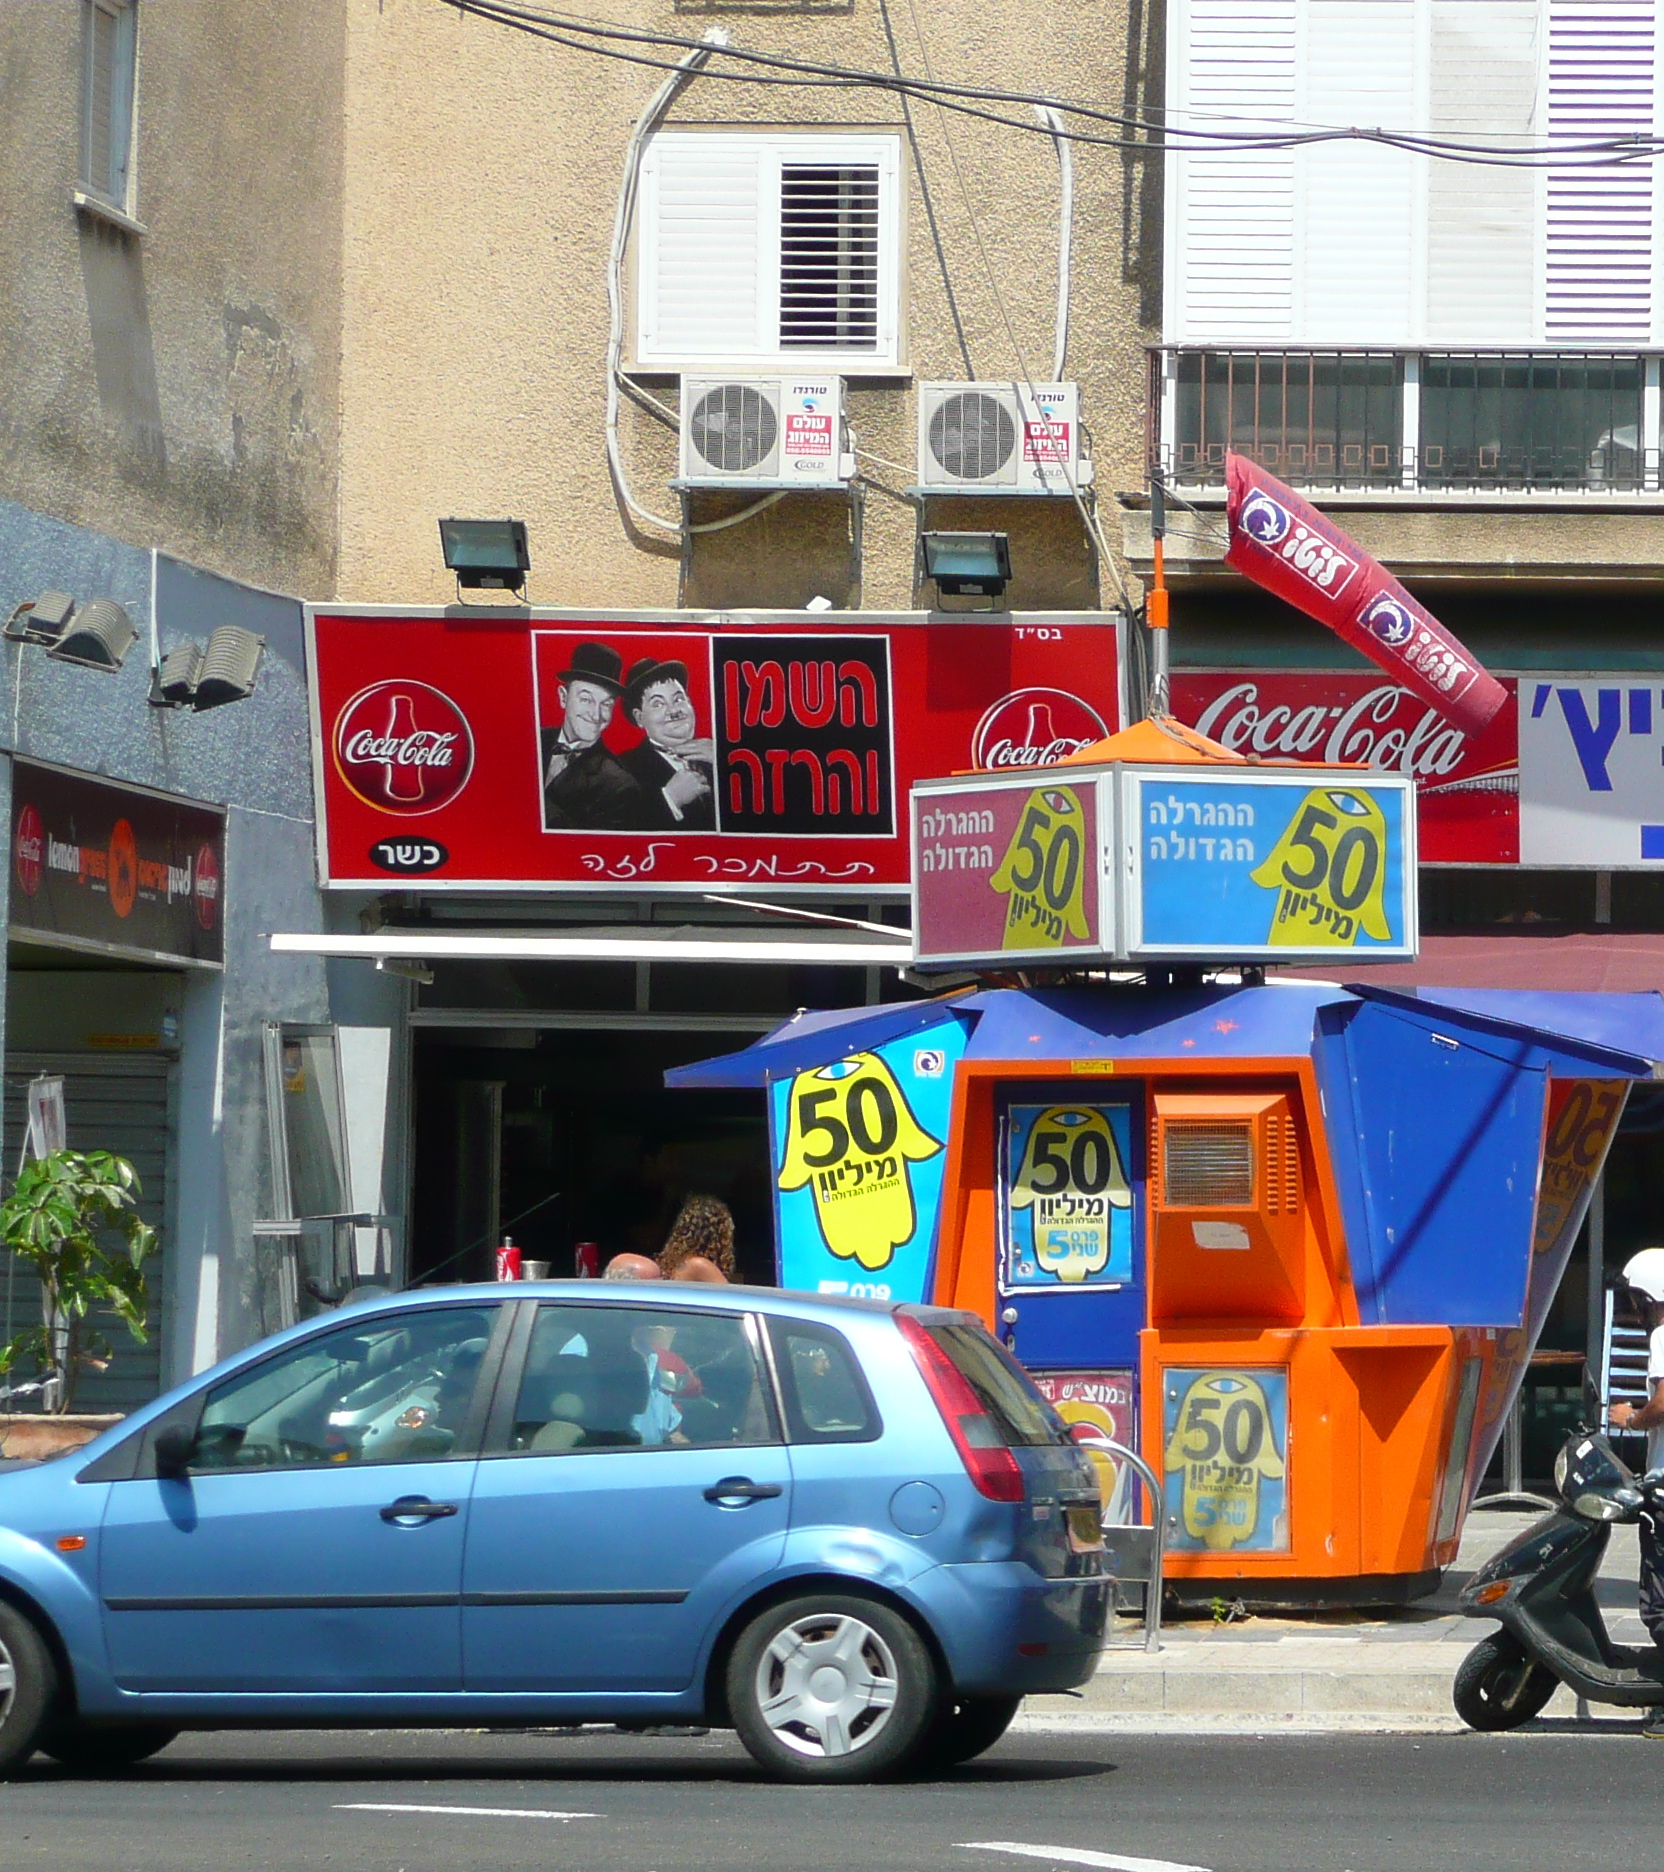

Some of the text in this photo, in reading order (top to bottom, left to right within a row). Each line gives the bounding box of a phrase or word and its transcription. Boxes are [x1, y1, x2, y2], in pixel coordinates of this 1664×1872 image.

[792, 414, 826, 429] עולם
[787, 431, 830, 444] המיזוג
[800, 460, 825, 470] GOLD
[724, 659, 877, 743] השמן
[1195, 683, 1466, 775] Coca-Cola
[345, 728, 458, 767] Coca-Cola
[727, 748, 880, 816] והרזה
[921, 807, 994, 838] ההגרלה
[1150, 795, 1255, 827] ההגרלה
[378, 844, 442, 866] כשר
[581, 842, 876, 878] תתמכר לזה
[921, 842, 993, 872] הגדולה
[1010, 805, 1080, 911] 50
[1150, 834, 1255, 862] הגדולה
[1281, 804, 1379, 911] 50
[1009, 892, 1063, 940] מיליון
[1279, 889, 1355, 940] מיליון
[798, 1076, 898, 1168] 50
[1030, 1130, 1112, 1195] 50
[818, 1156, 898, 1202] מיליון
[831, 1178, 900, 1202] ההגרלה הגדולה
[1040, 1193, 1104, 1222] מיליון
[1046, 1230, 1070, 1259] 5
[1070, 1230, 1099, 1242] פרס
[1071, 1242, 1099, 1257] שני
[1183, 1397, 1263, 1464] 50
[1190, 1459, 1254, 1489] מיליון
[1193, 1498, 1217, 1527] 5
